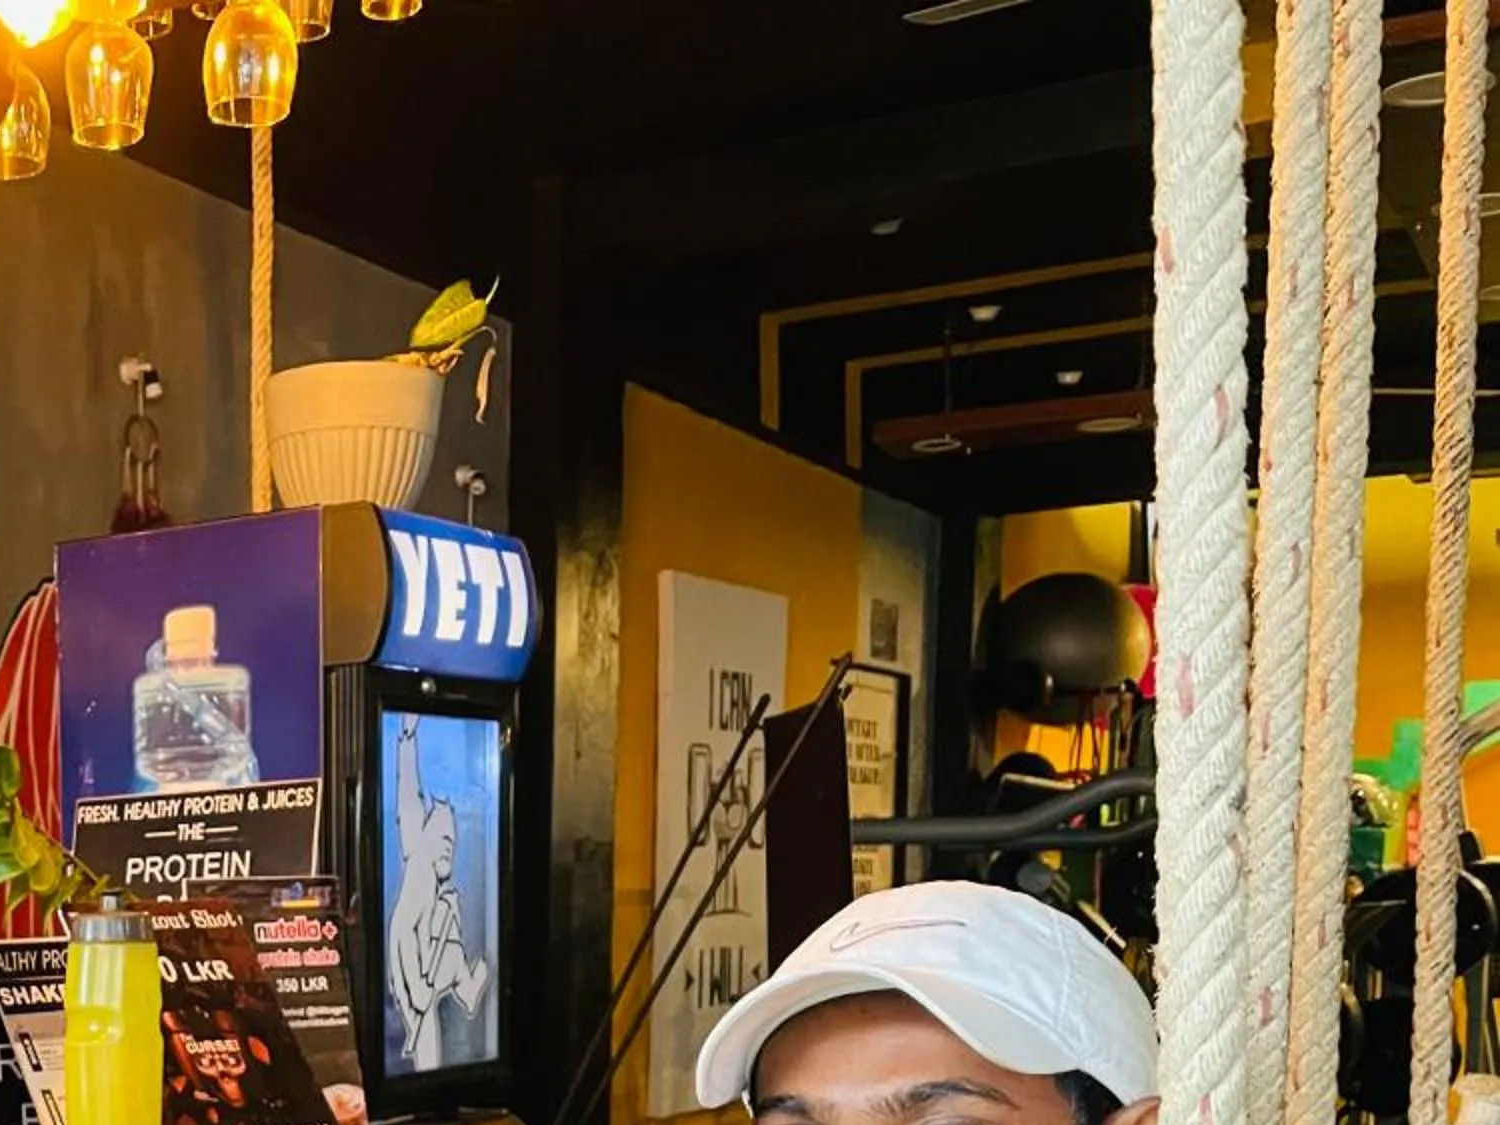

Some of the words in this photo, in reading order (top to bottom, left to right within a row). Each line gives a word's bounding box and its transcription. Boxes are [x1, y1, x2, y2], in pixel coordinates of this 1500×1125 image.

[389, 529, 529, 648] YETI
[123, 799, 182, 822] HEALTHY
[182, 793, 245, 817] PROTEIN
[247, 792, 260, 811] &
[262, 786, 315, 810] JUICES
[177, 822, 207, 842] THE
[125, 849, 252, 885] PROTEIN
[191, 908, 238, 930] Shot
[254, 914, 322, 944] nutella
[182, 959, 234, 983] LKR
[301, 975, 329, 993] LKR
